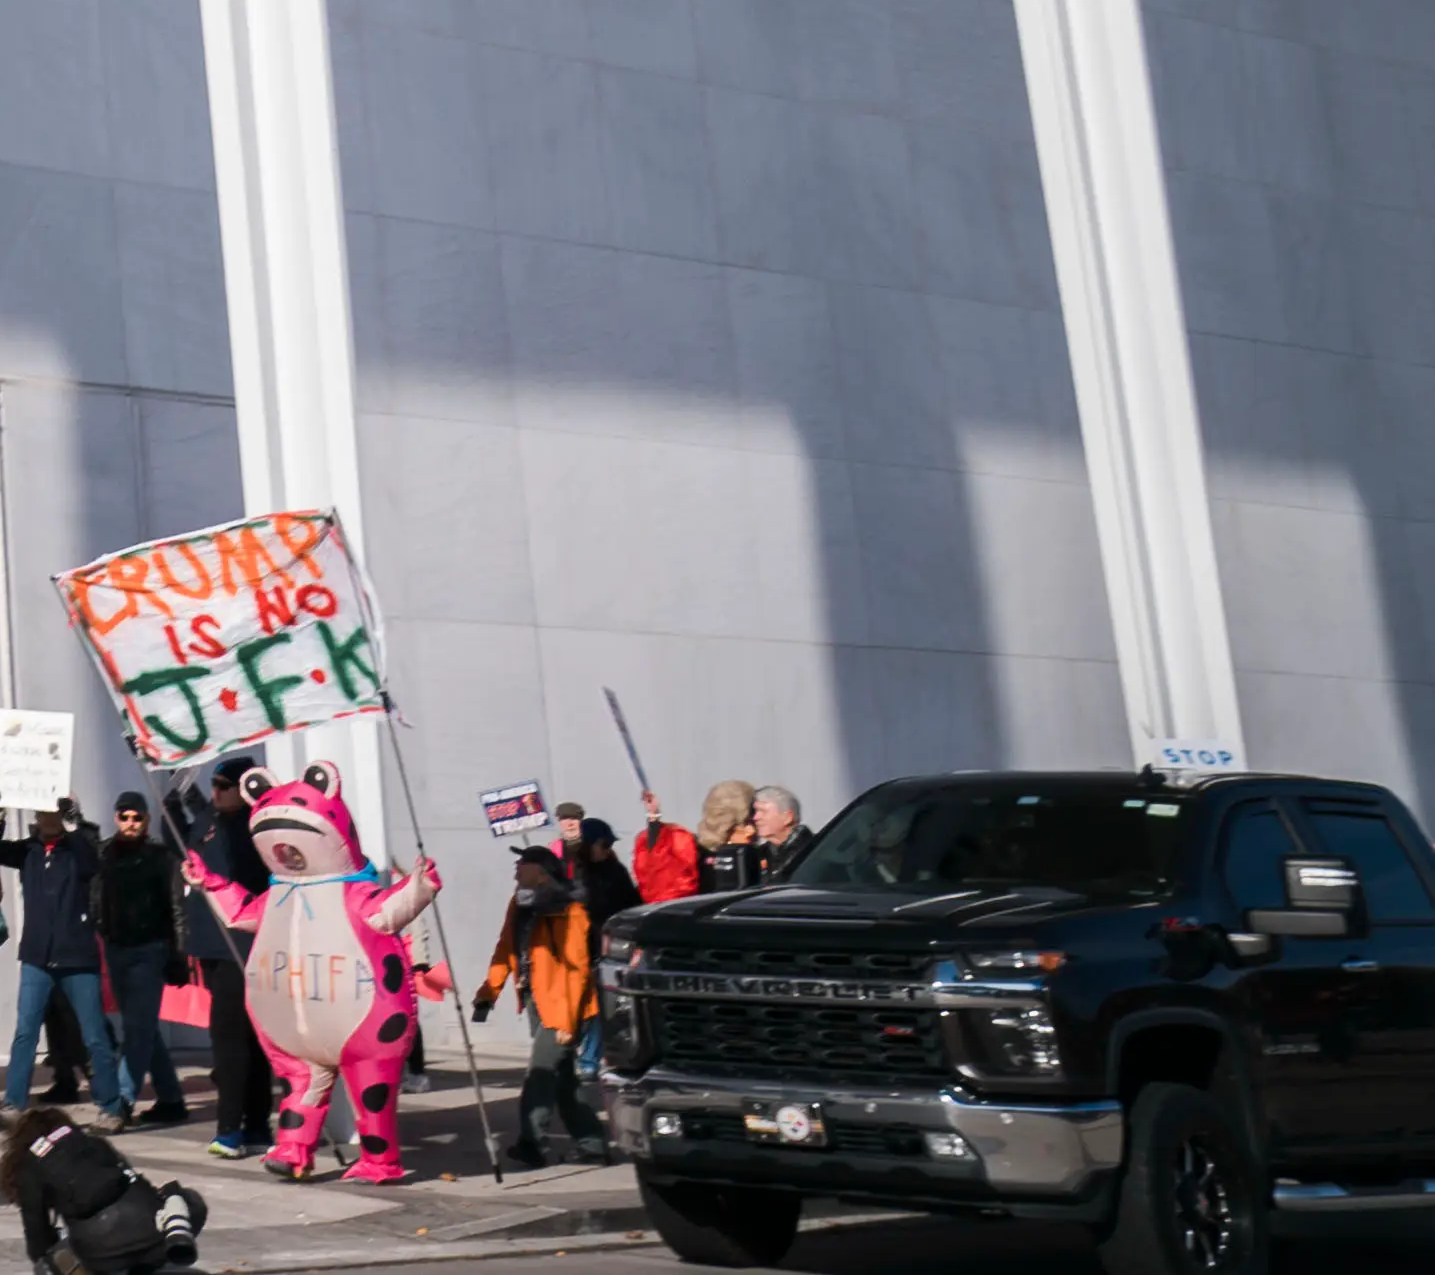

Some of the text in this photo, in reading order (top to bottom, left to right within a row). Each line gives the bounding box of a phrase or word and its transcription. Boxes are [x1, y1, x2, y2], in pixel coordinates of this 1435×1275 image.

[163, 584, 339, 666] IS NO
[1162, 748, 1233, 766] STOP
